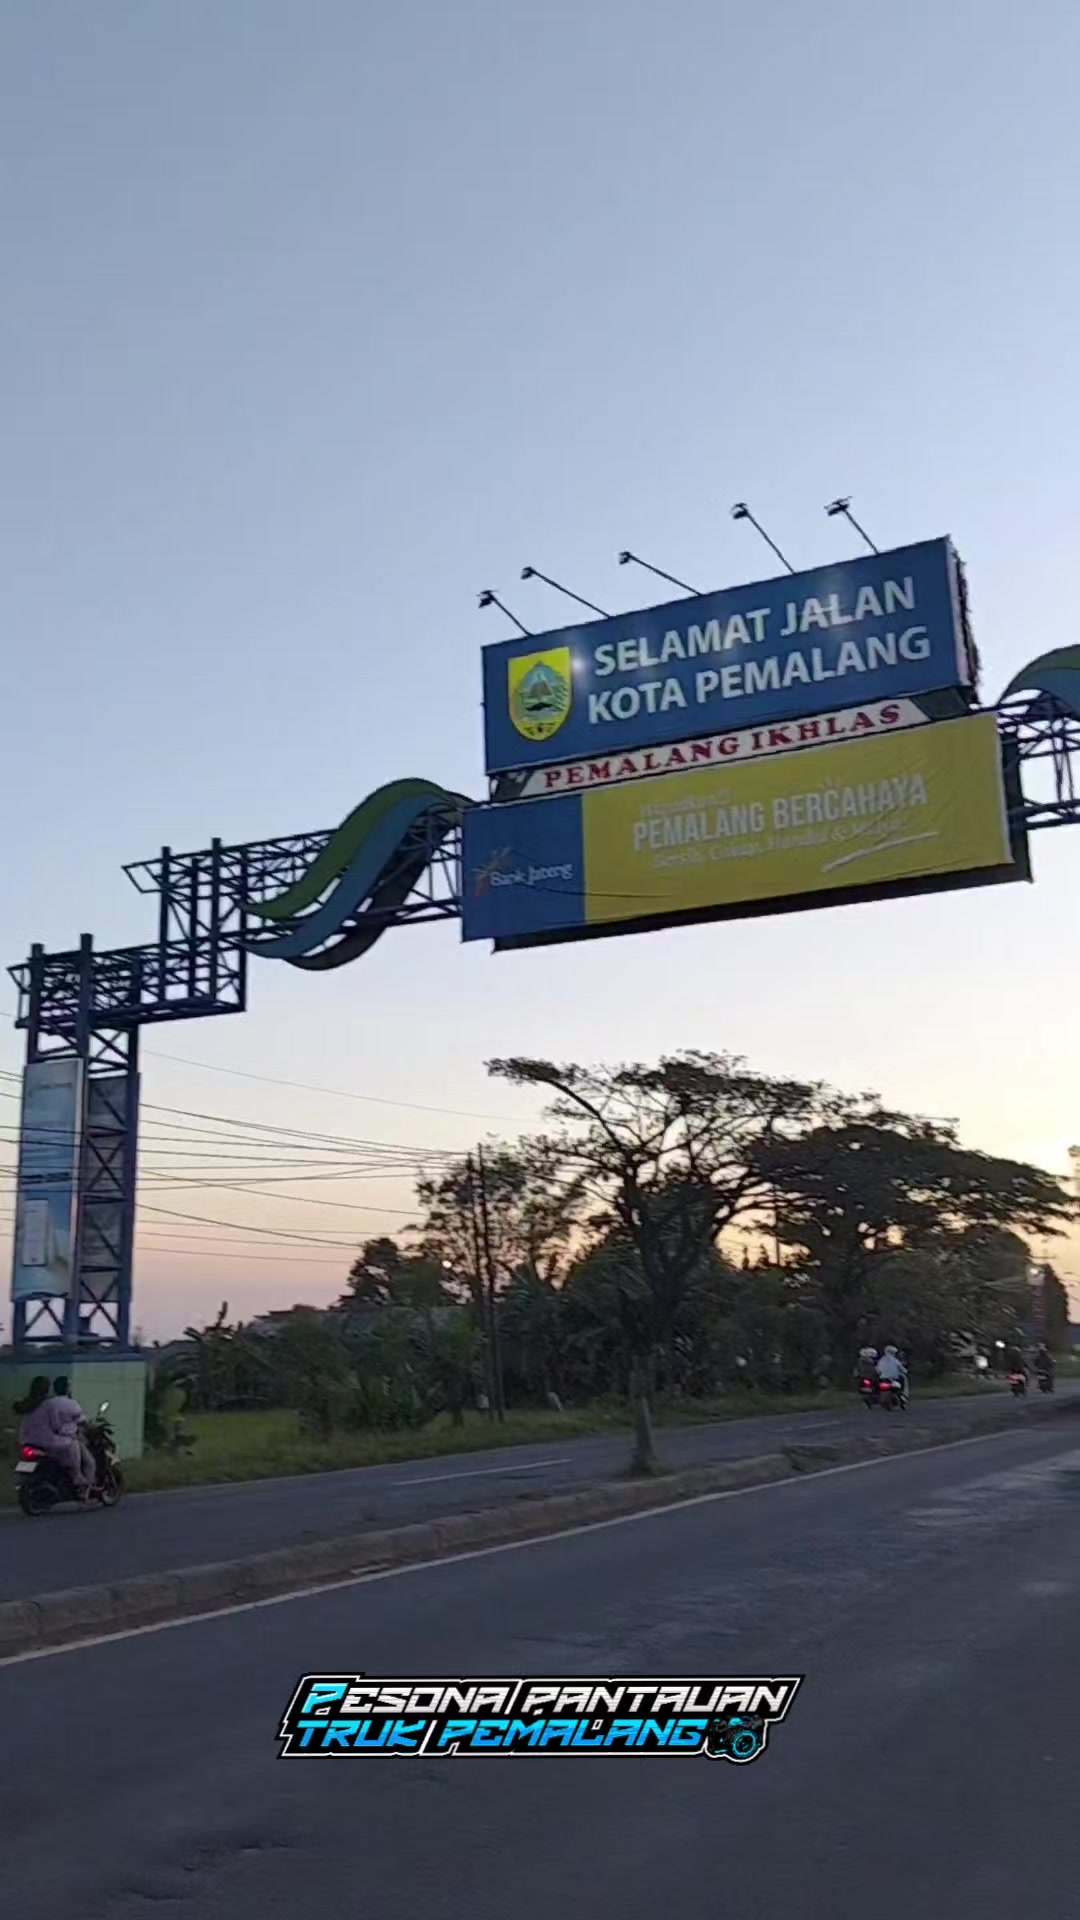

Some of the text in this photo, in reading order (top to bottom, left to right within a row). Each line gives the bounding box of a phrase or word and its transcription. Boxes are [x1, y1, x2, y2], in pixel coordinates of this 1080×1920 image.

[594, 576, 915, 676] SELAMAT JALAN
[588, 625, 931, 724] KOTA PEMALANG
[545, 704, 900, 788] PEMALANG IKHLAS
[633, 802, 764, 850] PEMALANG
[772, 775, 928, 829] BERCAHAYA
